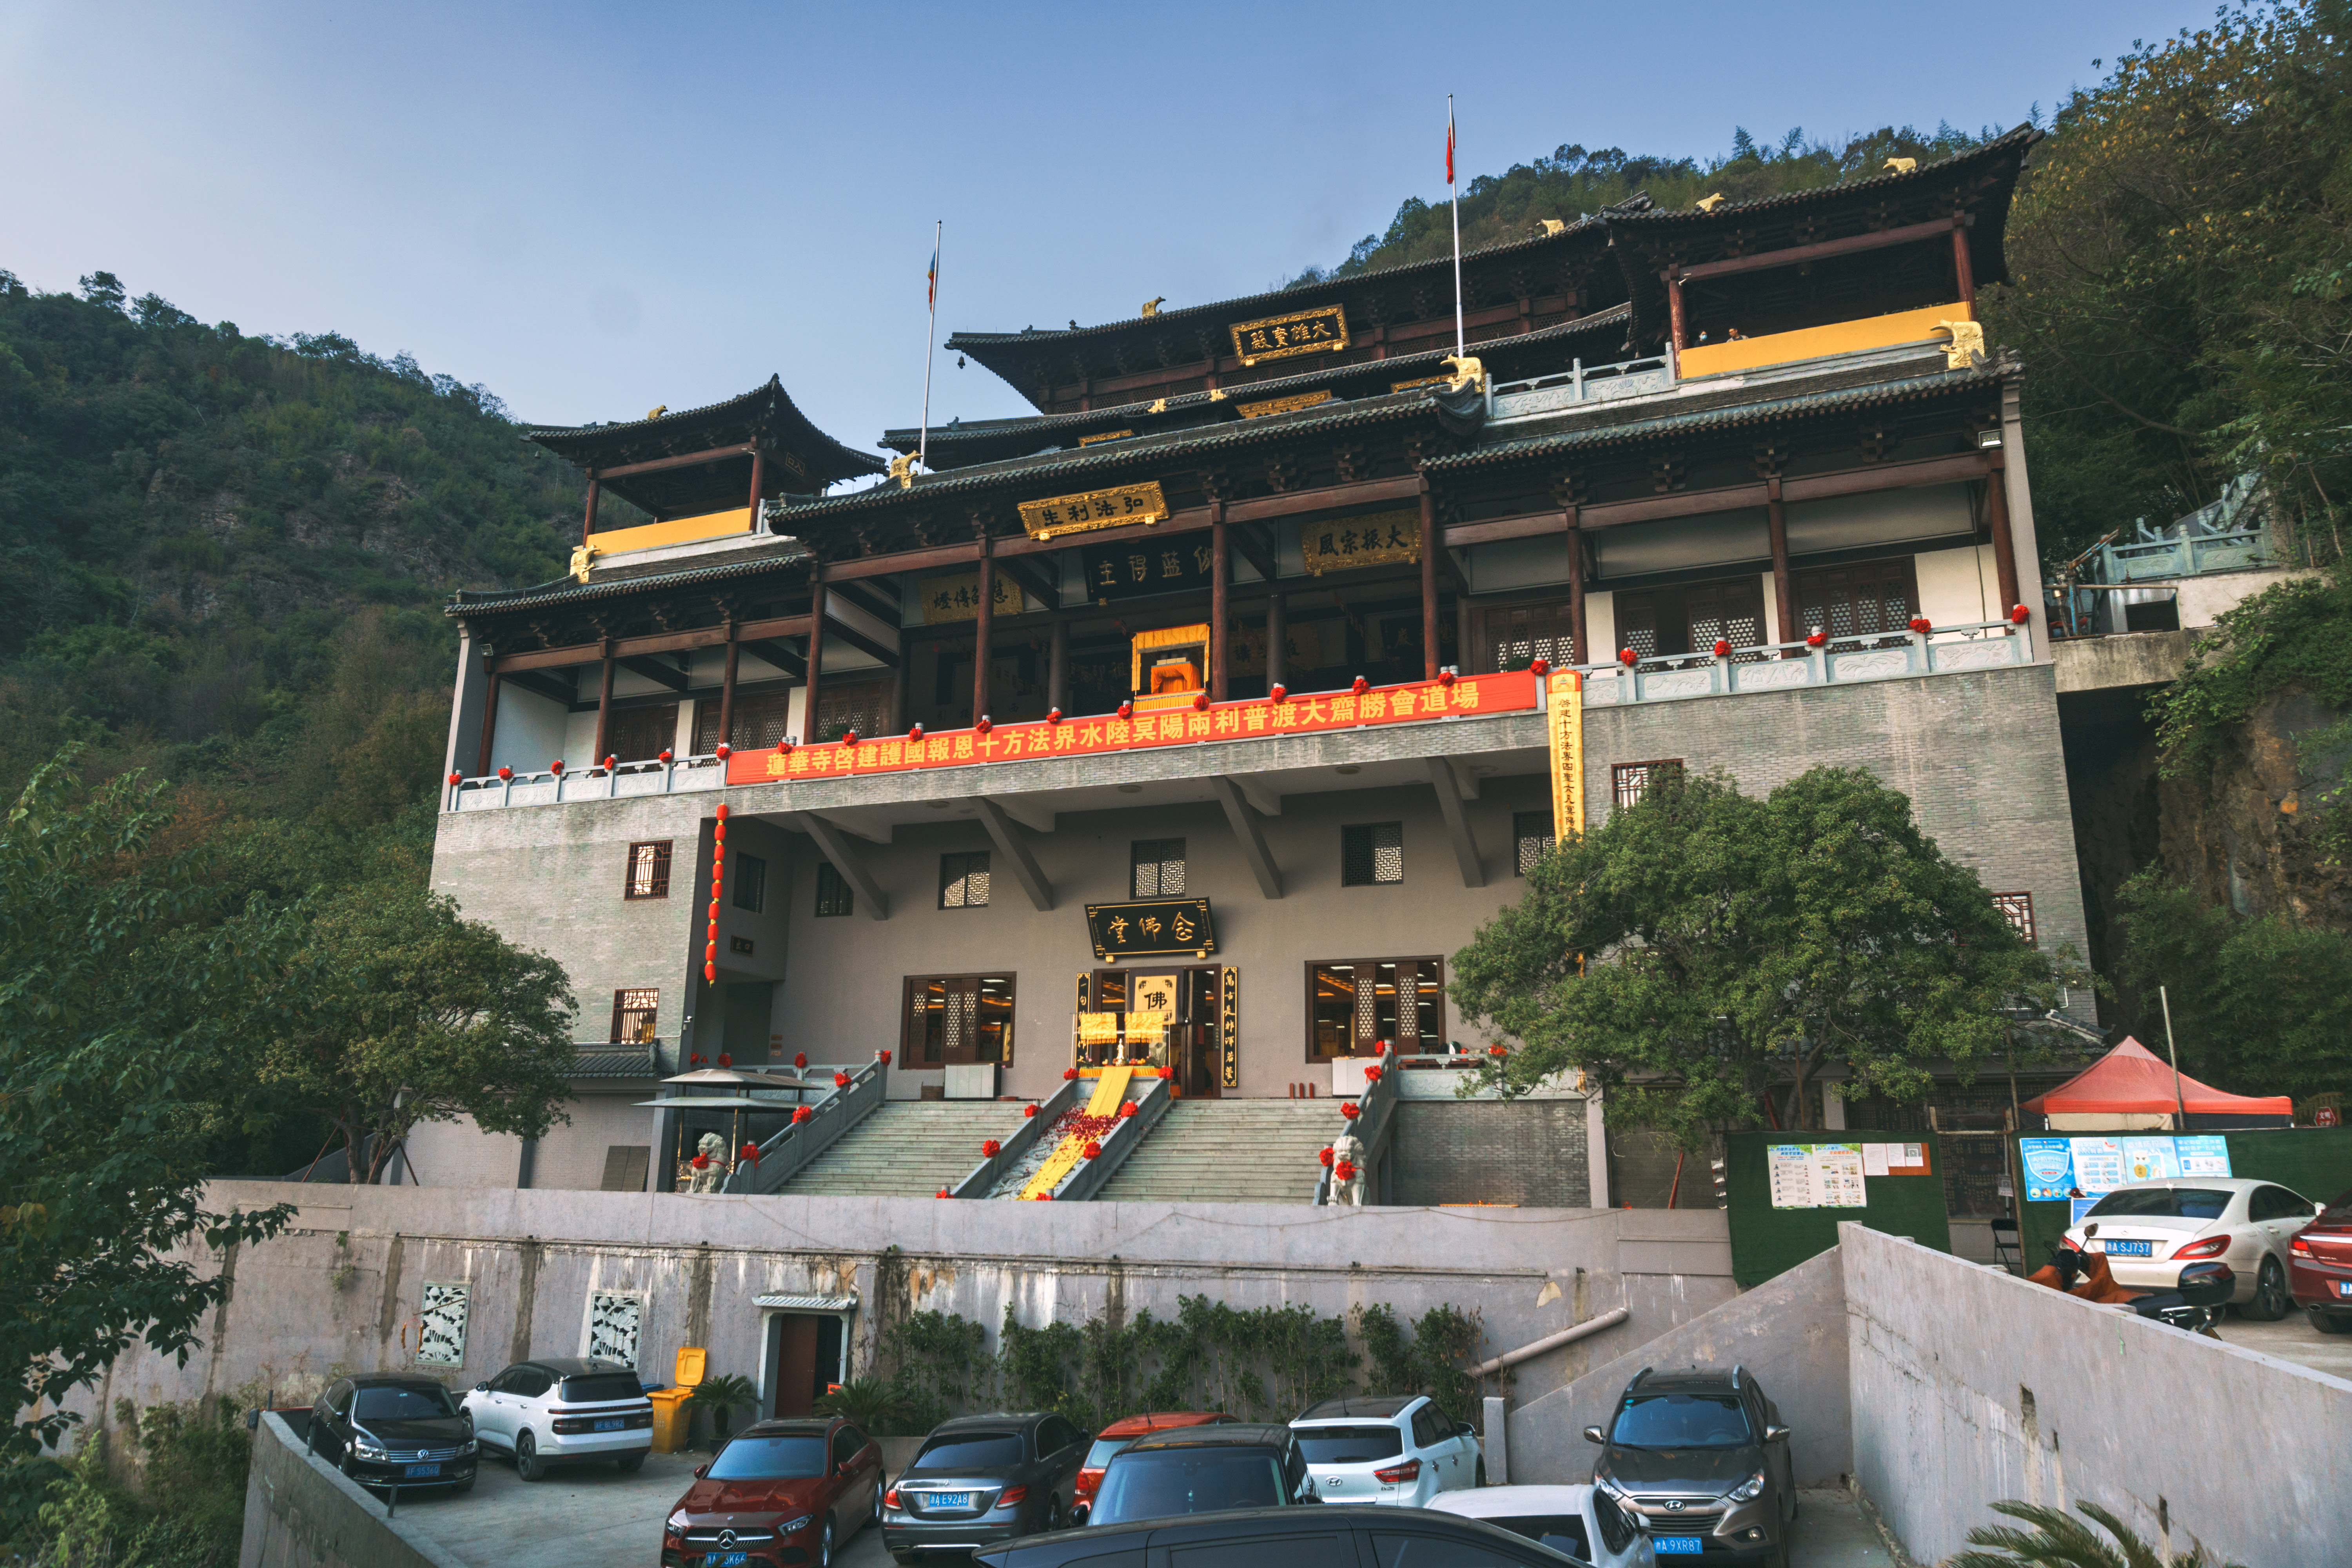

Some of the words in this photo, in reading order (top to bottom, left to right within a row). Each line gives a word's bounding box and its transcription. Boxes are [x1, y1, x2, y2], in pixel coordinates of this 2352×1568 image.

[1042, 496, 1143, 527] 弘法利生
[1318, 524, 1408, 557] 大振宗風
[1107, 911, 1195, 944] 念佛堂
[1143, 991, 1167, 1009] 佛
